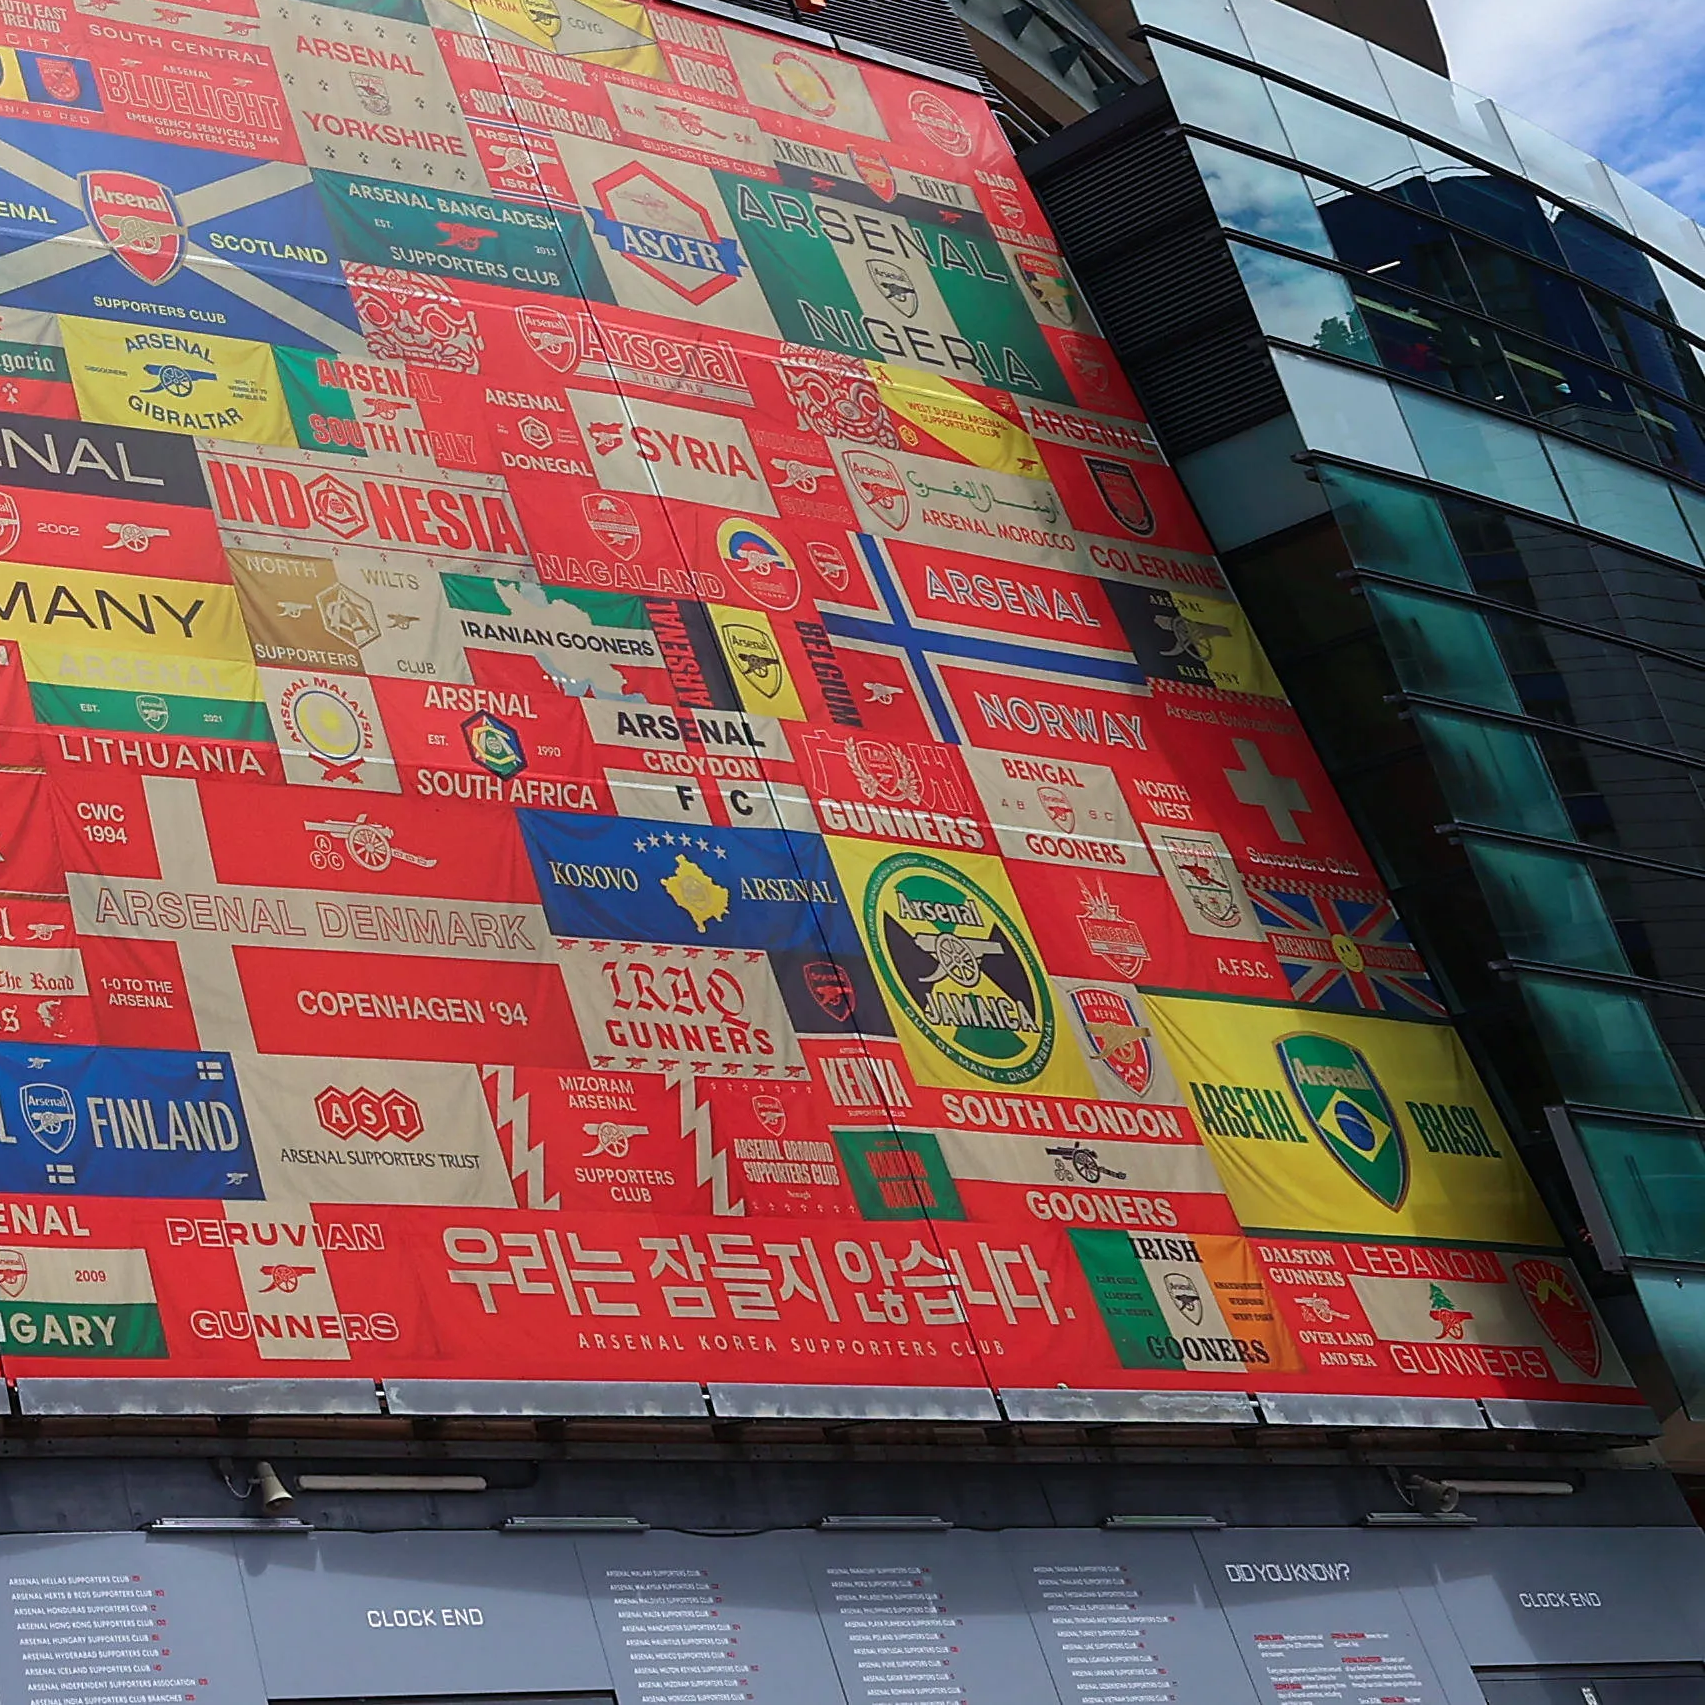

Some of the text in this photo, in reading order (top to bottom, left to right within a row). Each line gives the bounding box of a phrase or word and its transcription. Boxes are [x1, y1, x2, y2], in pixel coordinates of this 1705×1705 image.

[302, 110, 468, 160] YORKSHIRE
[500, 177, 564, 198] ISRAEL
[208, 232, 330, 266] SCOTLAND
[798, 300, 1042, 390] NIGERIA
[127, 395, 244, 432] GIBRALTAR
[503, 451, 593, 478] DONEGAL
[637, 430, 757, 482] SYRIA
[1090, 545, 1226, 589] COLERAINE
[460, 620, 656, 658] IRANIAN GOONERS
[978, 691, 1149, 751] NORWAY
[59, 737, 266, 776] LITHUANIA
[642, 750, 760, 778] CROYDON
[548, 862, 838, 905] KOSOVO ARSENAL
[922, 991, 1039, 1034] JAMAICA
[558, 1076, 635, 1096] MIZORAM
[818, 1056, 913, 1108] KENYA
[88, 1096, 240, 1153] FINLAND
[1188, 1082, 1502, 1159] ARSENAL BRASIL
[165, 1216, 385, 1251] PERUVIAN
[1128, 1236, 1203, 1264] IRISH
[443, 1227, 1076, 1326] 우리는 잠들지 않습니다.
[1345, 1245, 1497, 1282] LEBANON
[578, 1332, 1005, 1357] ARSENAL KOREA SUPPORTERS CLUB
[366, 1608, 484, 1628] CLOCK END
[1519, 1592, 1602, 1608] CLOCK END
